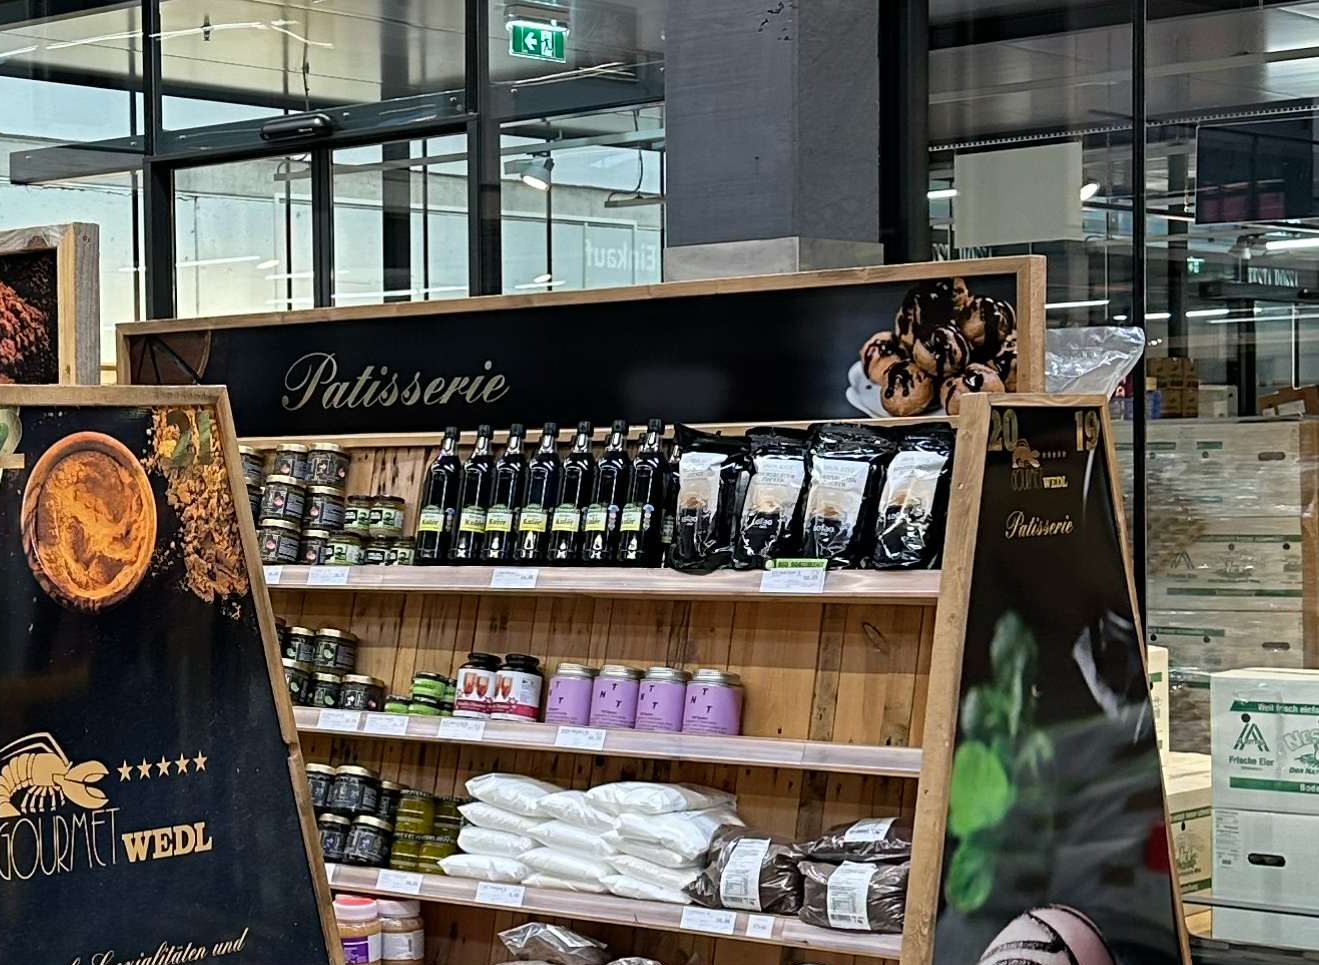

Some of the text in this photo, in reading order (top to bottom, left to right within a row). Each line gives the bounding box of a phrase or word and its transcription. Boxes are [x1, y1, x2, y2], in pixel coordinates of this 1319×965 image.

[281, 352, 510, 411] Patisserie
[987, 408, 1101, 452] 20 19
[1042, 475, 1068, 489] WEDL
[1005, 510, 1075, 539] Patisserie
[1282, 728, 1319, 752] NES
[121, 821, 213, 864] WEDL
[212, 927, 249, 957] und
